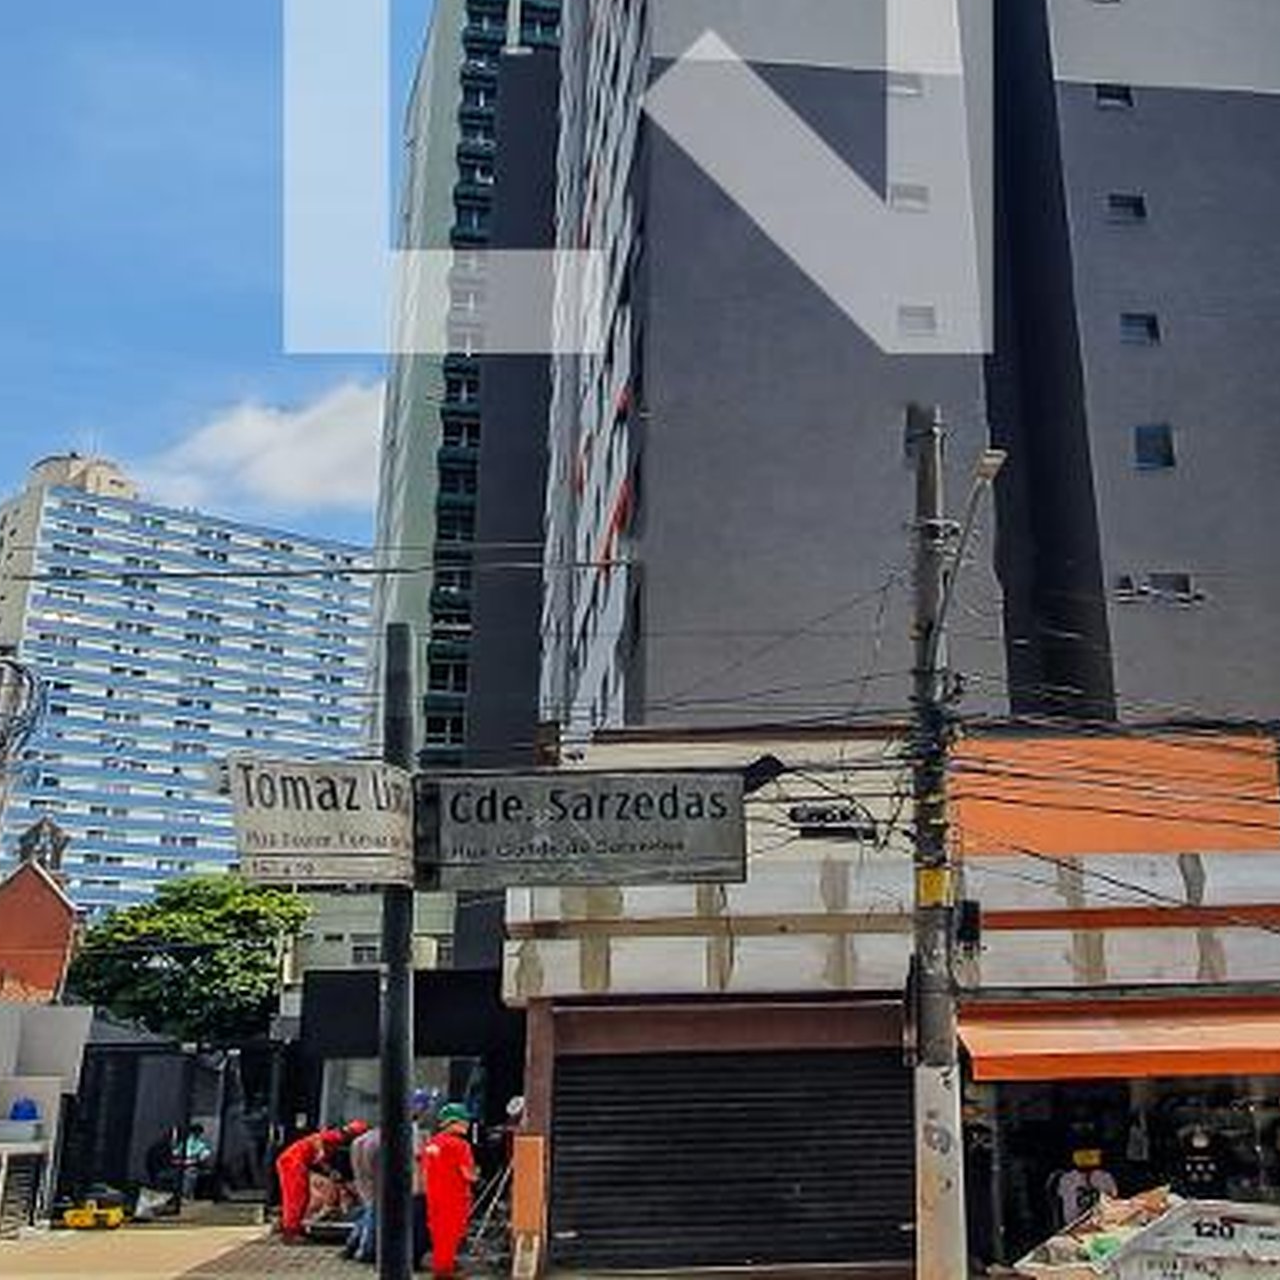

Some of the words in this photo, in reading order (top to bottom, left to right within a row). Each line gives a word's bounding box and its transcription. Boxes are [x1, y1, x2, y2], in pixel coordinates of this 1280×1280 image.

[236, 762, 361, 811] Tomaz
[449, 789, 533, 823] Cde.
[539, 783, 729, 822] Sarzedas
[1193, 1219, 1236, 1240] 120
